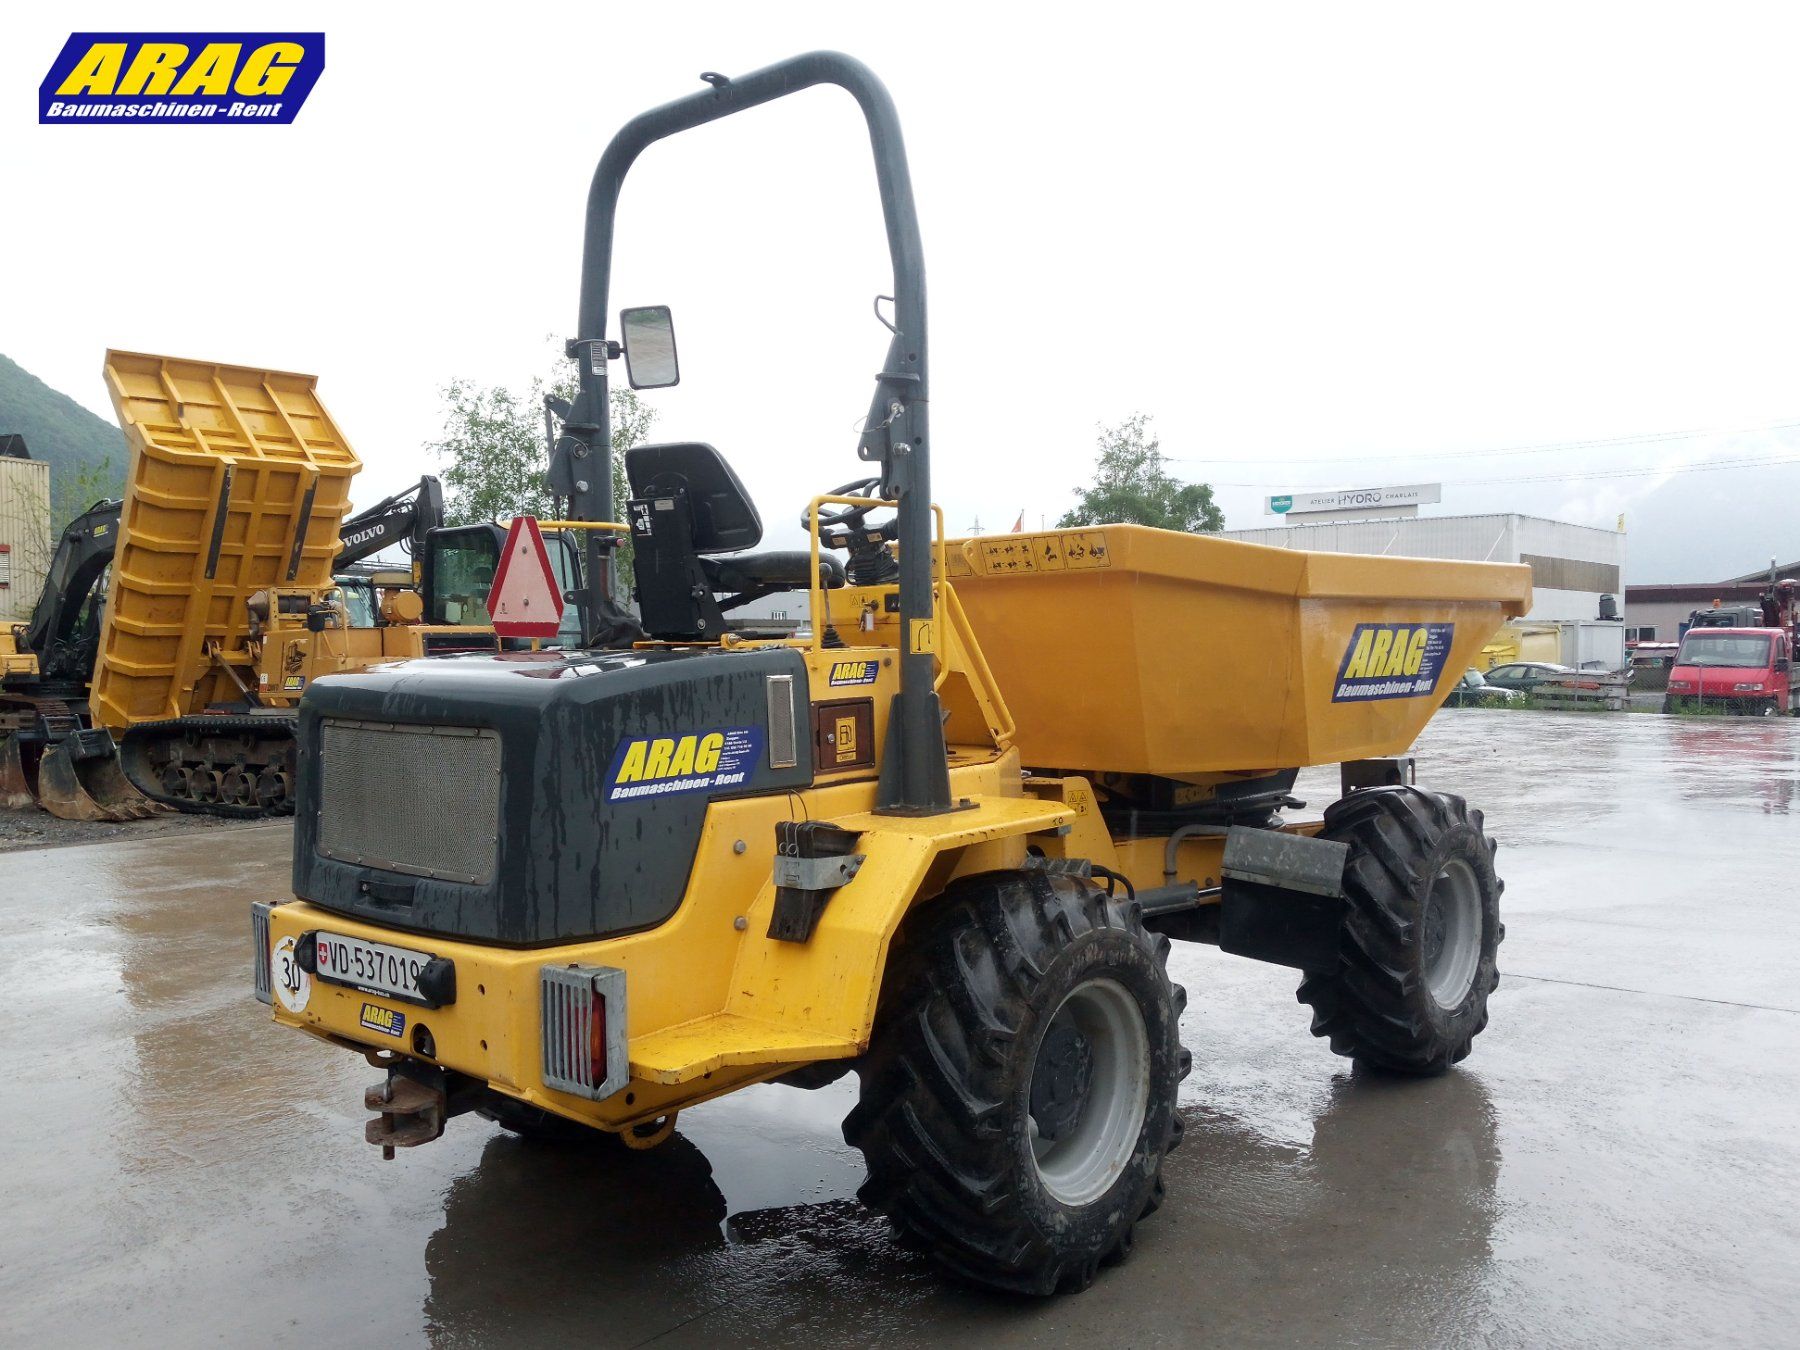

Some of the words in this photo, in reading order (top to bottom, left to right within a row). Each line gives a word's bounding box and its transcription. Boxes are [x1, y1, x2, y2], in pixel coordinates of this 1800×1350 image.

[1338, 493, 1382, 505] HYDRO
[343, 524, 385, 547] VOLVO
[1343, 628, 1428, 679] ARAG
[832, 662, 867, 680] ARAG
[615, 732, 725, 784] ARAG
[281, 957, 301, 992] 30
[362, 1004, 394, 1028] ARAG
